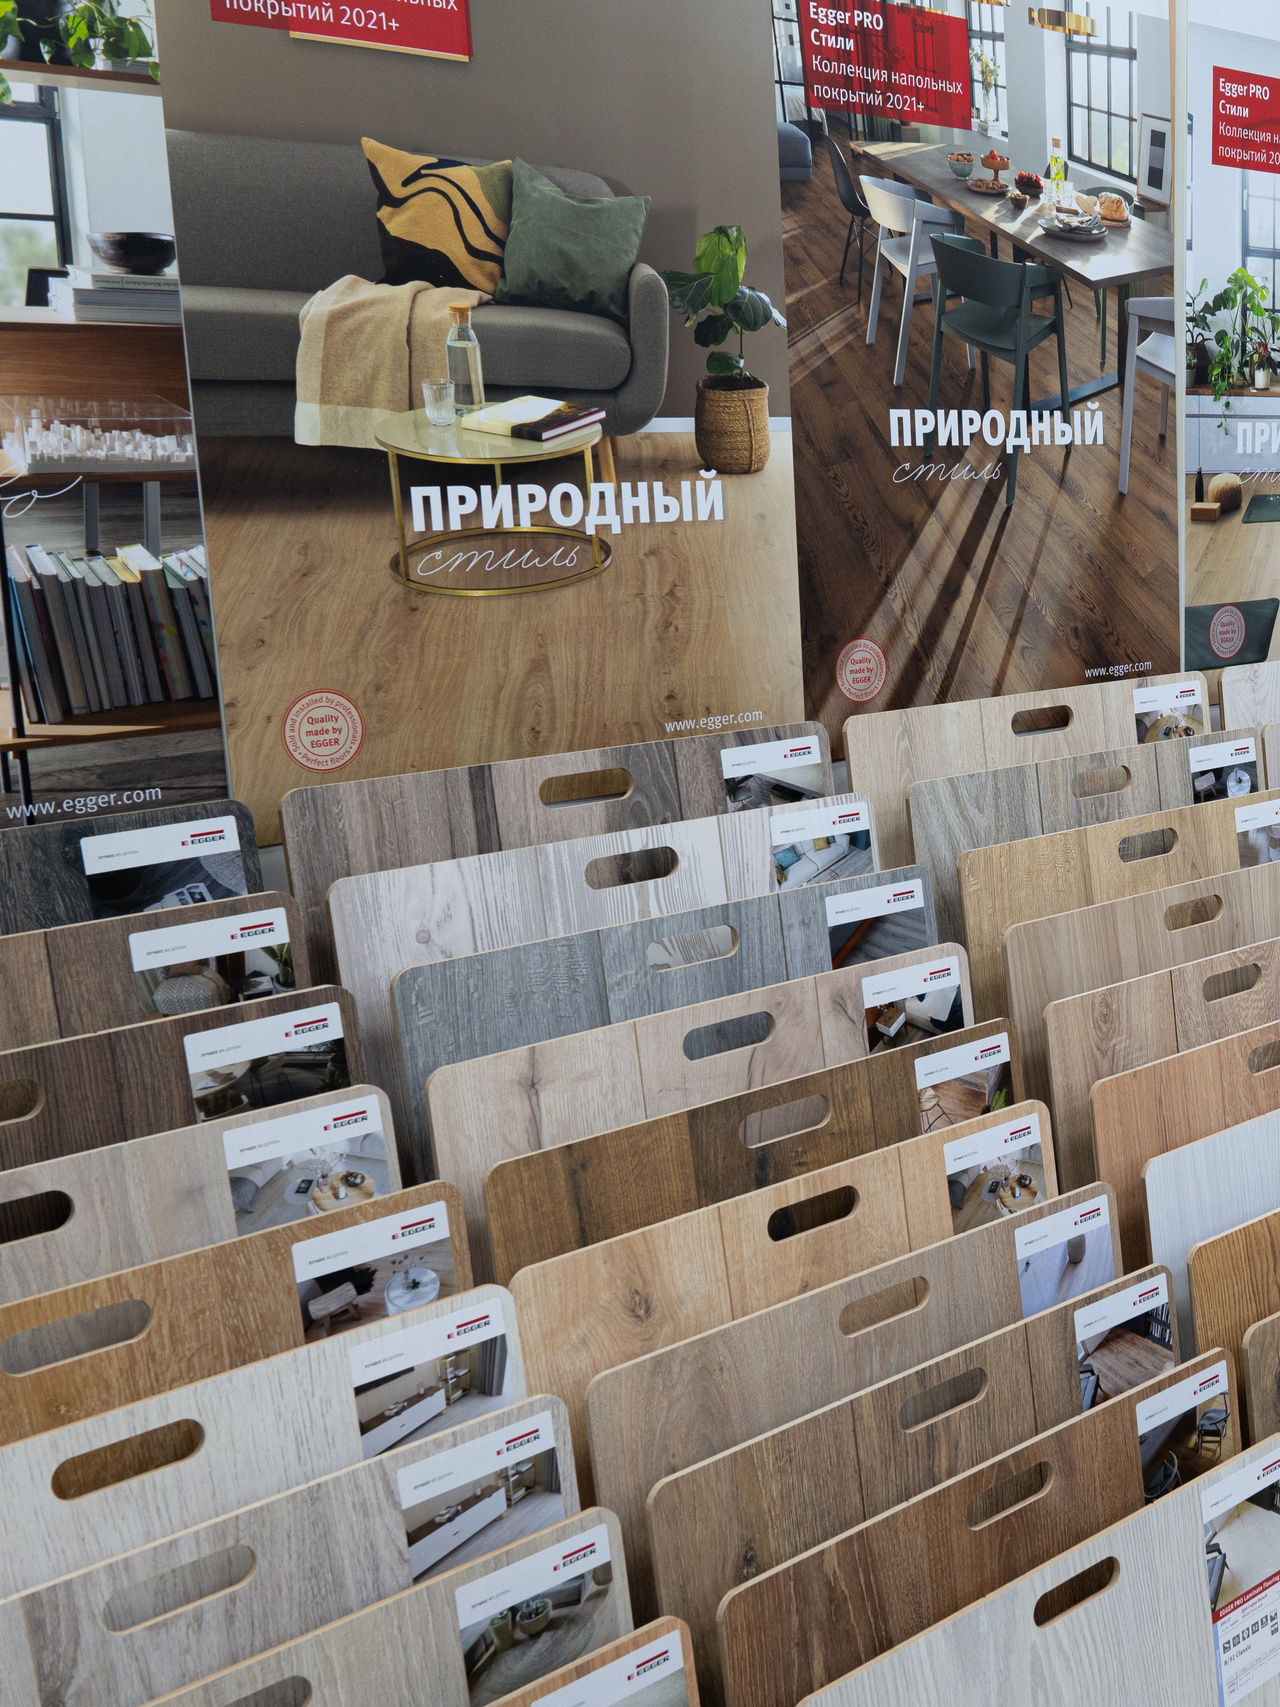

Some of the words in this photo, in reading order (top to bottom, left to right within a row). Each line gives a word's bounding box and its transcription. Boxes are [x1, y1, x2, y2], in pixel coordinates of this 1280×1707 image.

[340, 6, 400, 31] 2021+
[809, 1, 851, 26] Egger
[854, 9, 884, 31] PRO
[810, 28, 854, 51] Стили
[812, 54, 888, 83] Коллекция
[891, 72, 964, 95] напольных
[813, 84, 883, 107] покрытий
[886, 92, 925, 112] 2021+
[1219, 77, 1248, 98] Egger
[1249, 83, 1270, 100] PRO
[1219, 99, 1249, 118] Стили
[1219, 121, 1272, 143] Коллекция
[1218, 145, 1267, 163] покрытий
[889, 401, 1104, 454] ПРИРОДНЫЙ
[892, 462, 1003, 483] стиль
[410, 468, 724, 535] ПРИРОДНЫЙ
[417, 545, 580, 576] стиль
[851, 657, 872, 665] Quality
[866, 666, 874, 674] by
[1084, 660, 1152, 678] www.egger.com
[852, 676, 871, 684] EGGER
[292, 696, 323, 718] installed
[306, 714, 339, 725] Quality
[665, 709, 763, 733] www.egger.com
[305, 728, 330, 737] made
[331, 726, 343, 735] by
[310, 738, 340, 749] EGGER
[301, 753, 329, 767] Perfect
[330, 750, 351, 765] floors
[6, 787, 162, 820] www.egger.com
[191, 835, 225, 844] EGGER
[240, 927, 275, 938] EGGER
[294, 1023, 329, 1035] EGGER
[334, 1115, 368, 1128] EGGER
[401, 1223, 435, 1237] EGGER
[457, 1320, 490, 1336] EGGER
[506, 1434, 540, 1452] EGGER
[563, 1548, 596, 1567] EGGER
[637, 1655, 669, 1676] EGGER
